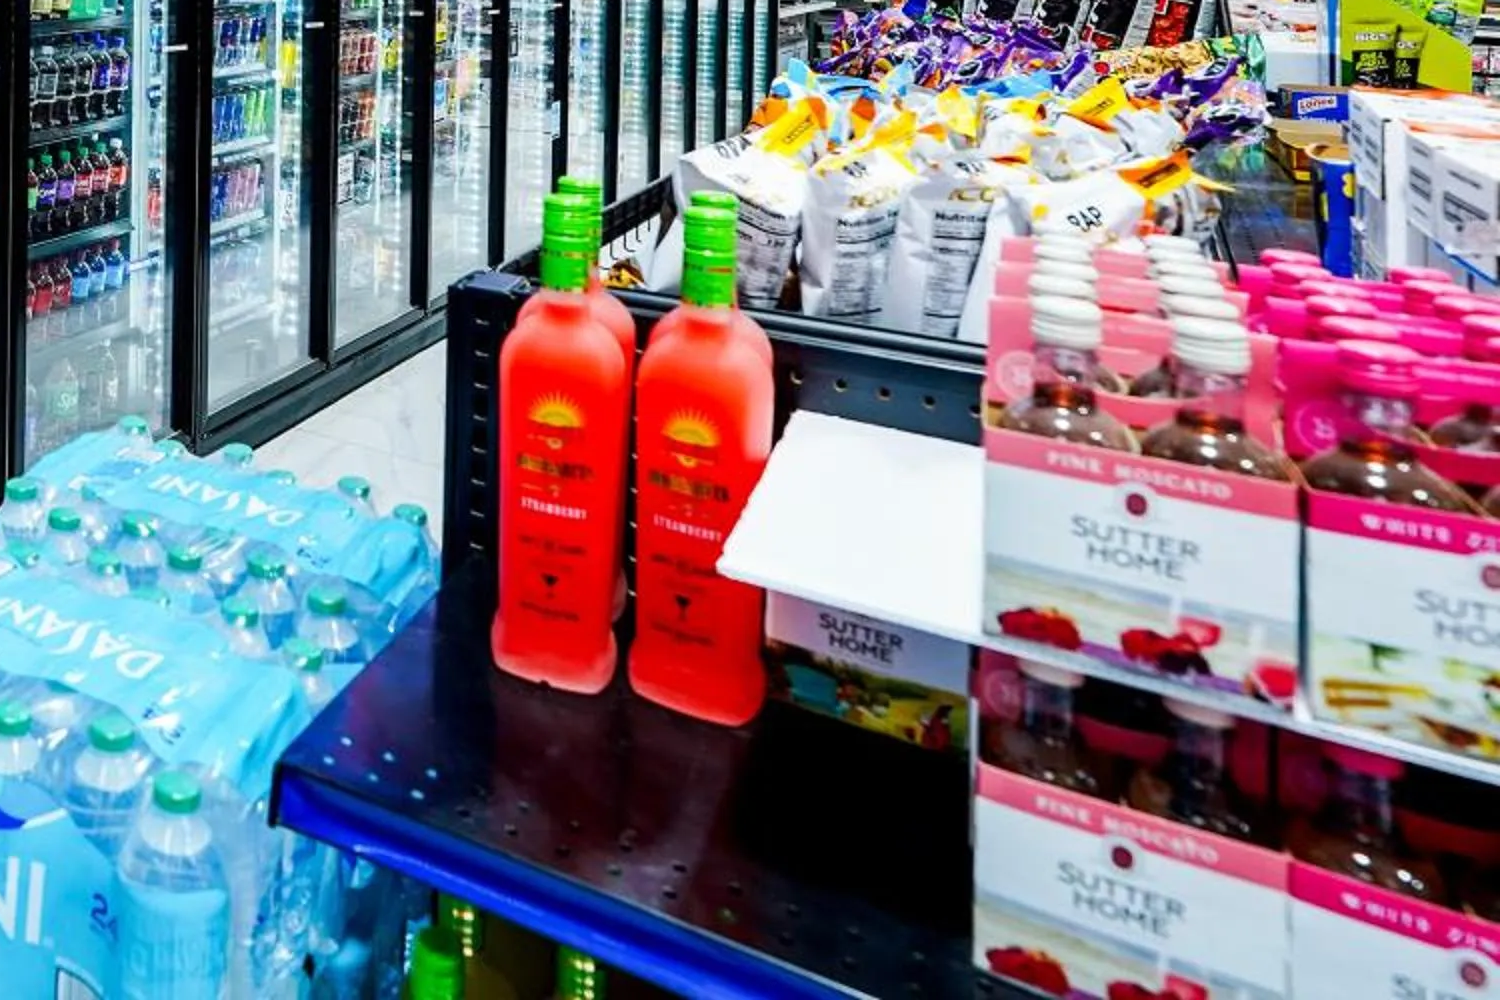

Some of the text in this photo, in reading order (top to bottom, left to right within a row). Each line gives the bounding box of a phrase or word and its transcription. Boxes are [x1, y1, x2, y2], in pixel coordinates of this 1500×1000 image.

[1046, 448, 1233, 501] PINK MOSCATO
[150, 474, 305, 527] DASANI
[520, 495, 588, 520] STRAWBERRY
[1070, 514, 1202, 562] SUTTER
[1360, 513, 1452, 545] WHITE
[1083, 543, 1186, 582] HOME
[817, 611, 904, 651] SUTTER
[829, 630, 895, 664] HOME
[1034, 794, 1221, 865] PINK MOSCATO
[1057, 860, 1187, 922] SUTTER
[1071, 889, 1171, 939] HOME
